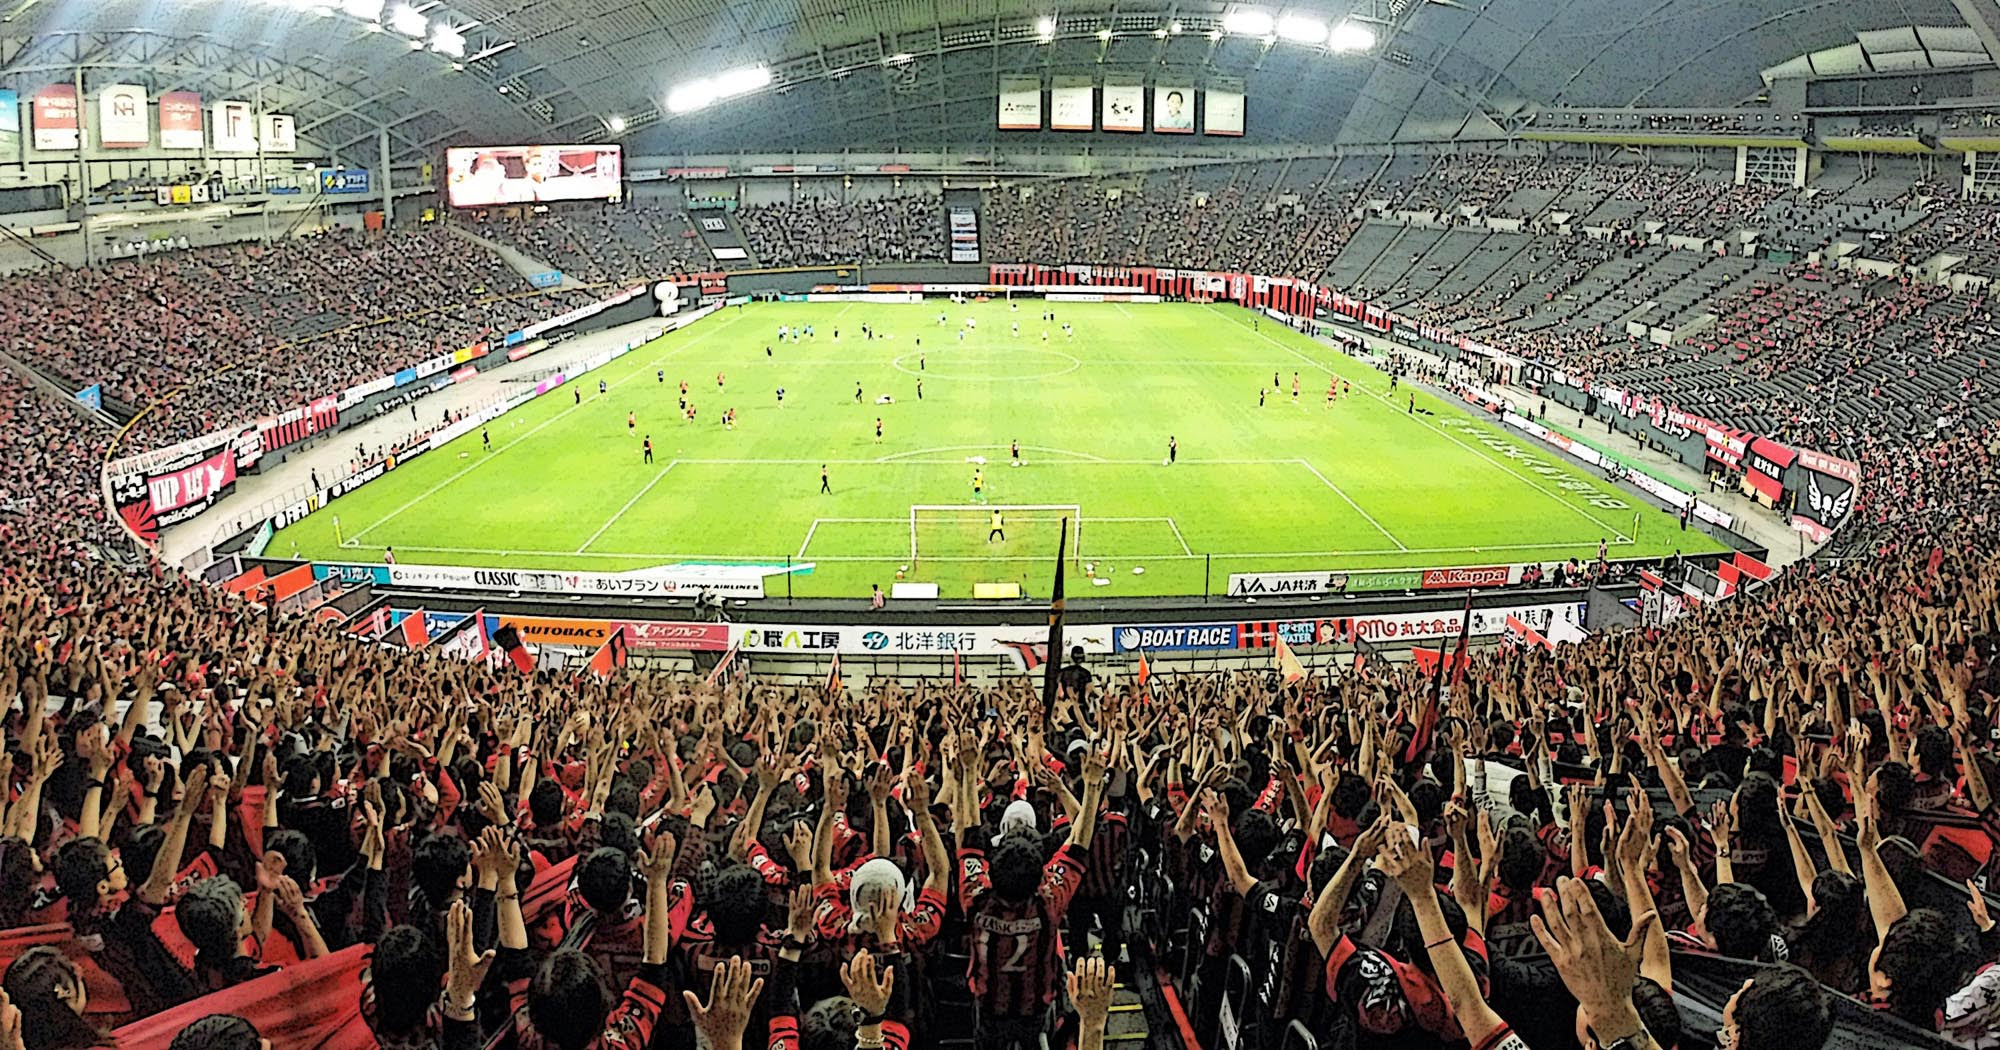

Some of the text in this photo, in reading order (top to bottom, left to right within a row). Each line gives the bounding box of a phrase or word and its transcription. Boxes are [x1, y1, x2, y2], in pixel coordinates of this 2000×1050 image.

[475, 571, 520, 587] CLASSIC
[596, 578, 658, 592] あいプラン
[1447, 570, 1506, 586] Kappa
[713, 583, 760, 592] AIRLINES
[1269, 579, 1318, 593] JA共済
[521, 626, 605, 639] AUTOBACS
[651, 626, 708, 638] アイングループ
[1278, 622, 1315, 635] SPORTS
[1401, 619, 1462, 636] 丸大食品
[896, 631, 976, 651] 北洋銀行
[1140, 629, 1184, 648] BOAT
[1186, 627, 1231, 646] RACE
